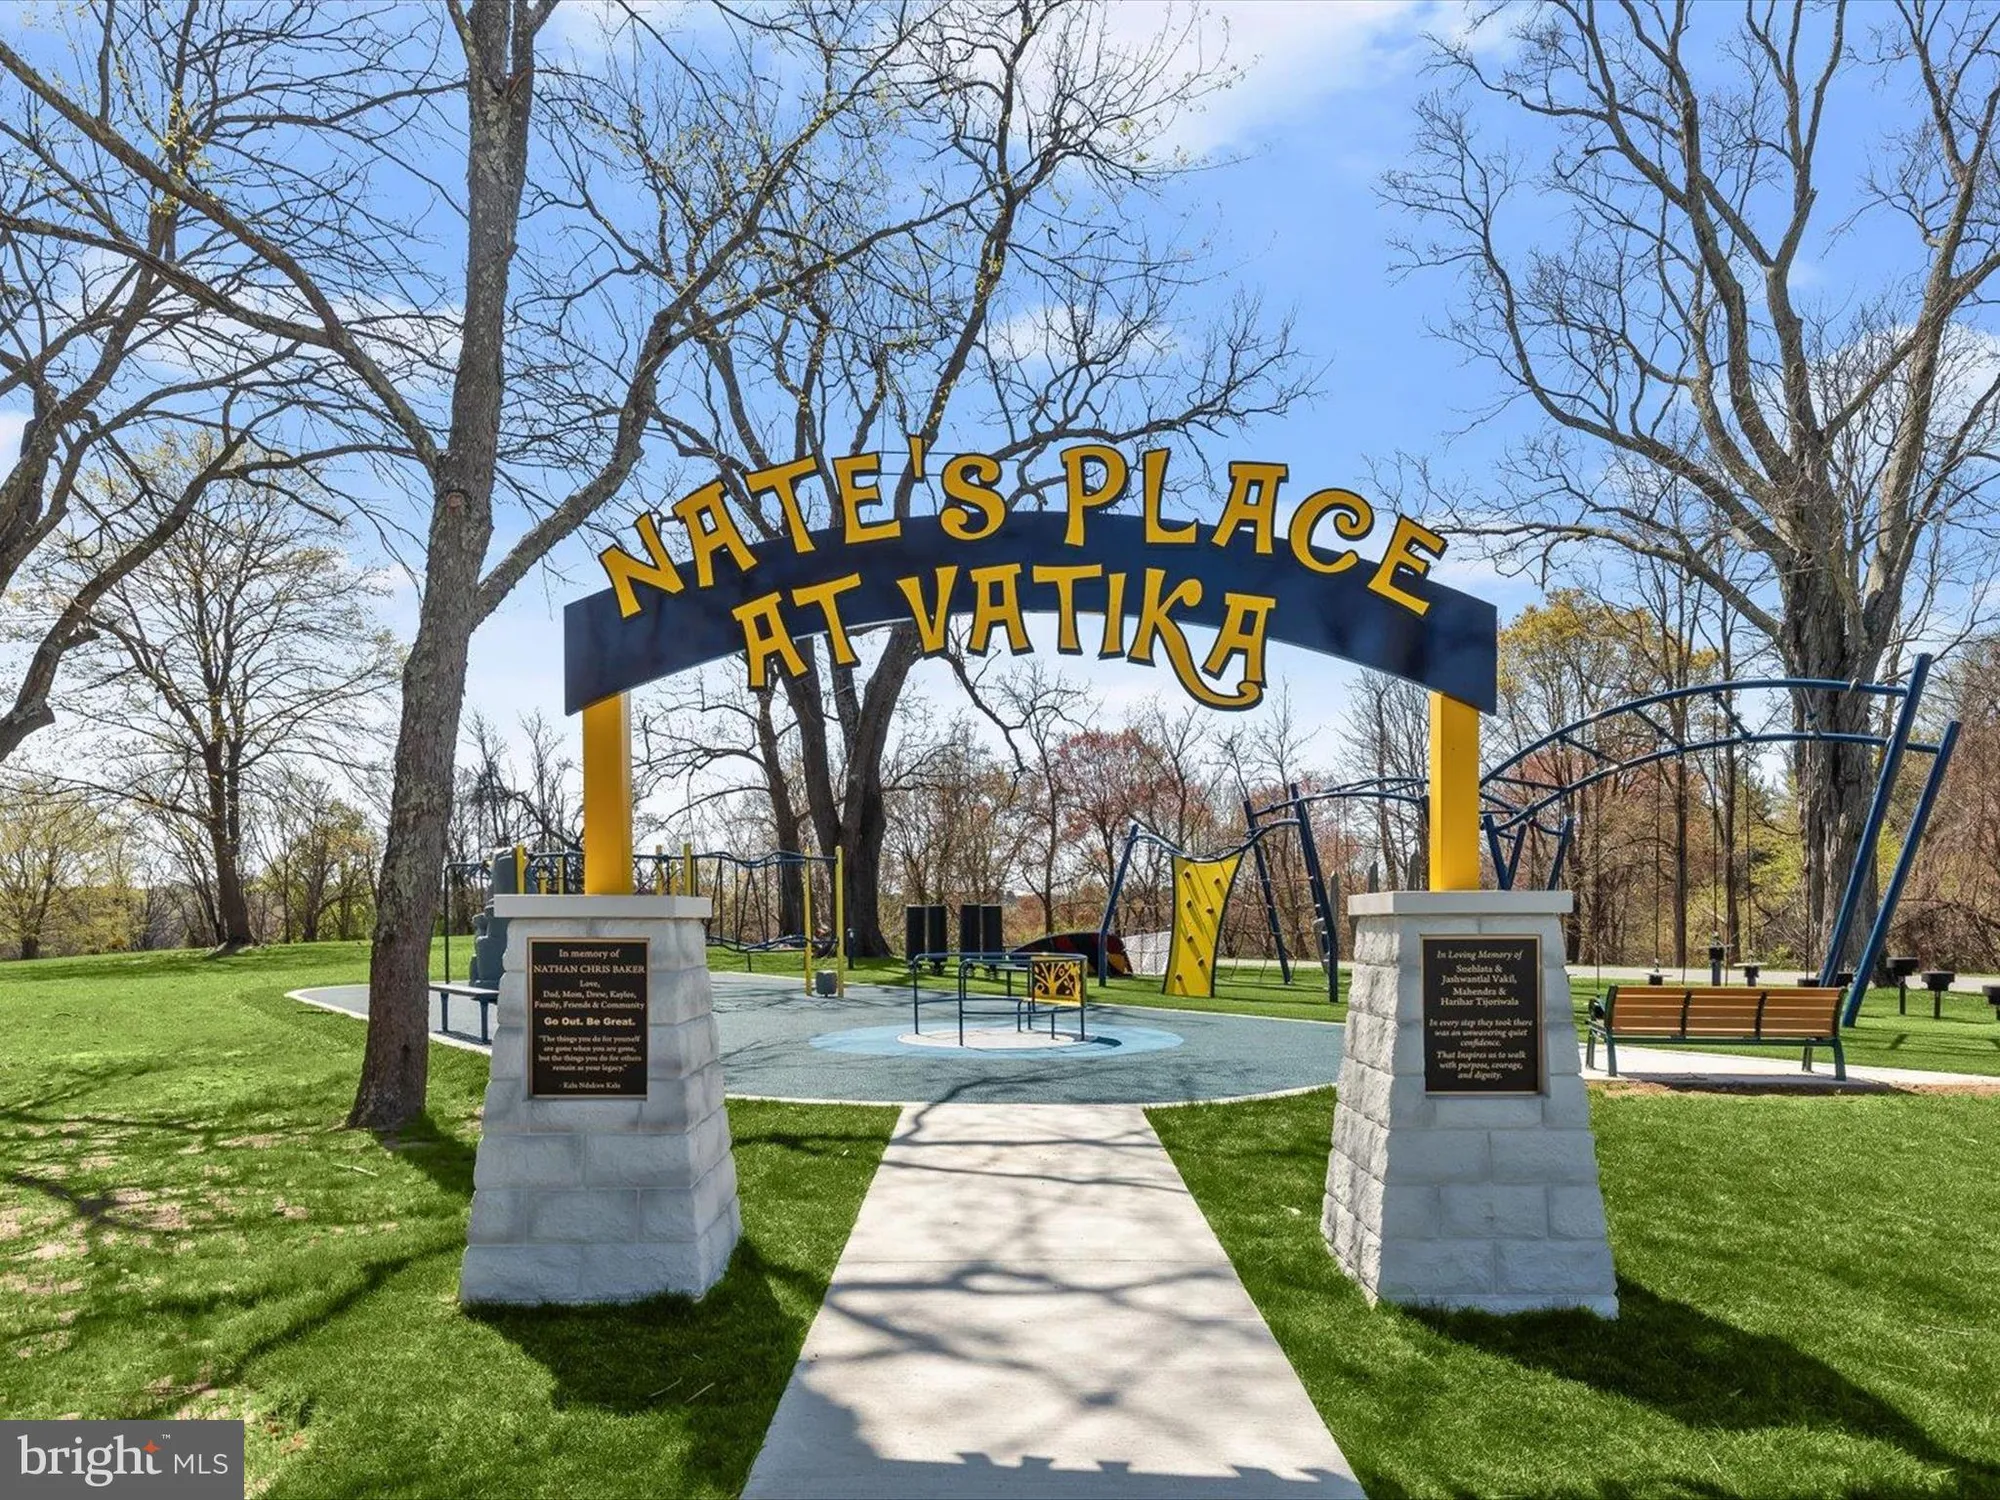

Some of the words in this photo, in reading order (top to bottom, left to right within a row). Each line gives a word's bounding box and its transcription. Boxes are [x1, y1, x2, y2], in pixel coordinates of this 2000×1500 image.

[598, 434, 1007, 620] NATE'S
[1060, 444, 1448, 616] PLACE
[731, 573, 862, 691] AT
[896, 563, 1277, 711] VATIKA
[559, 949, 569, 957] In
[571, 950, 607, 959] memory
[610, 949, 619, 957] of
[1448, 951, 1476, 960] Loving
[1478, 951, 1512, 960] Memory
[1513, 951, 1523, 960] of
[534, 965, 579, 973] NATHAN
[580, 965, 610, 973] CHRIS
[613, 965, 645, 973] BAKER
[1495, 965, 1503, 973] &
[580, 980, 600, 988] Love,
[1441, 975, 1490, 985] Jashwantlal
[543, 991, 560, 999] Dad,
[563, 991, 584, 999] Mom,
[586, 991, 608, 999] Drew,
[535, 1001, 562, 1009] Family,
[600, 1001, 644, 1009] Community
[544, 1017, 558, 1026] Go
[562, 1017, 583, 1026] Out.
[586, 1017, 600, 1026] Be
[603, 1017, 635, 1026] Great.
[1461, 1019, 1476, 1027] step
[1477, 1019, 1493, 1027] they
[1463, 1029, 1507, 1038] unwavering
[1508, 1029, 1528, 1038] quiet
[557, 1035, 577, 1043] things
[613, 1035, 640, 1043] yourself
[1460, 1039, 1501, 1047] confidence.
[564, 1055, 584, 1063] things
[1457, 1052, 1486, 1060] Inspires
[1507, 1051, 1525, 1059] walk
[1458, 1062, 1490, 1070] purpose,
[1491, 1062, 1523, 1070] courage,
[1474, 1072, 1503, 1080] dignity.
